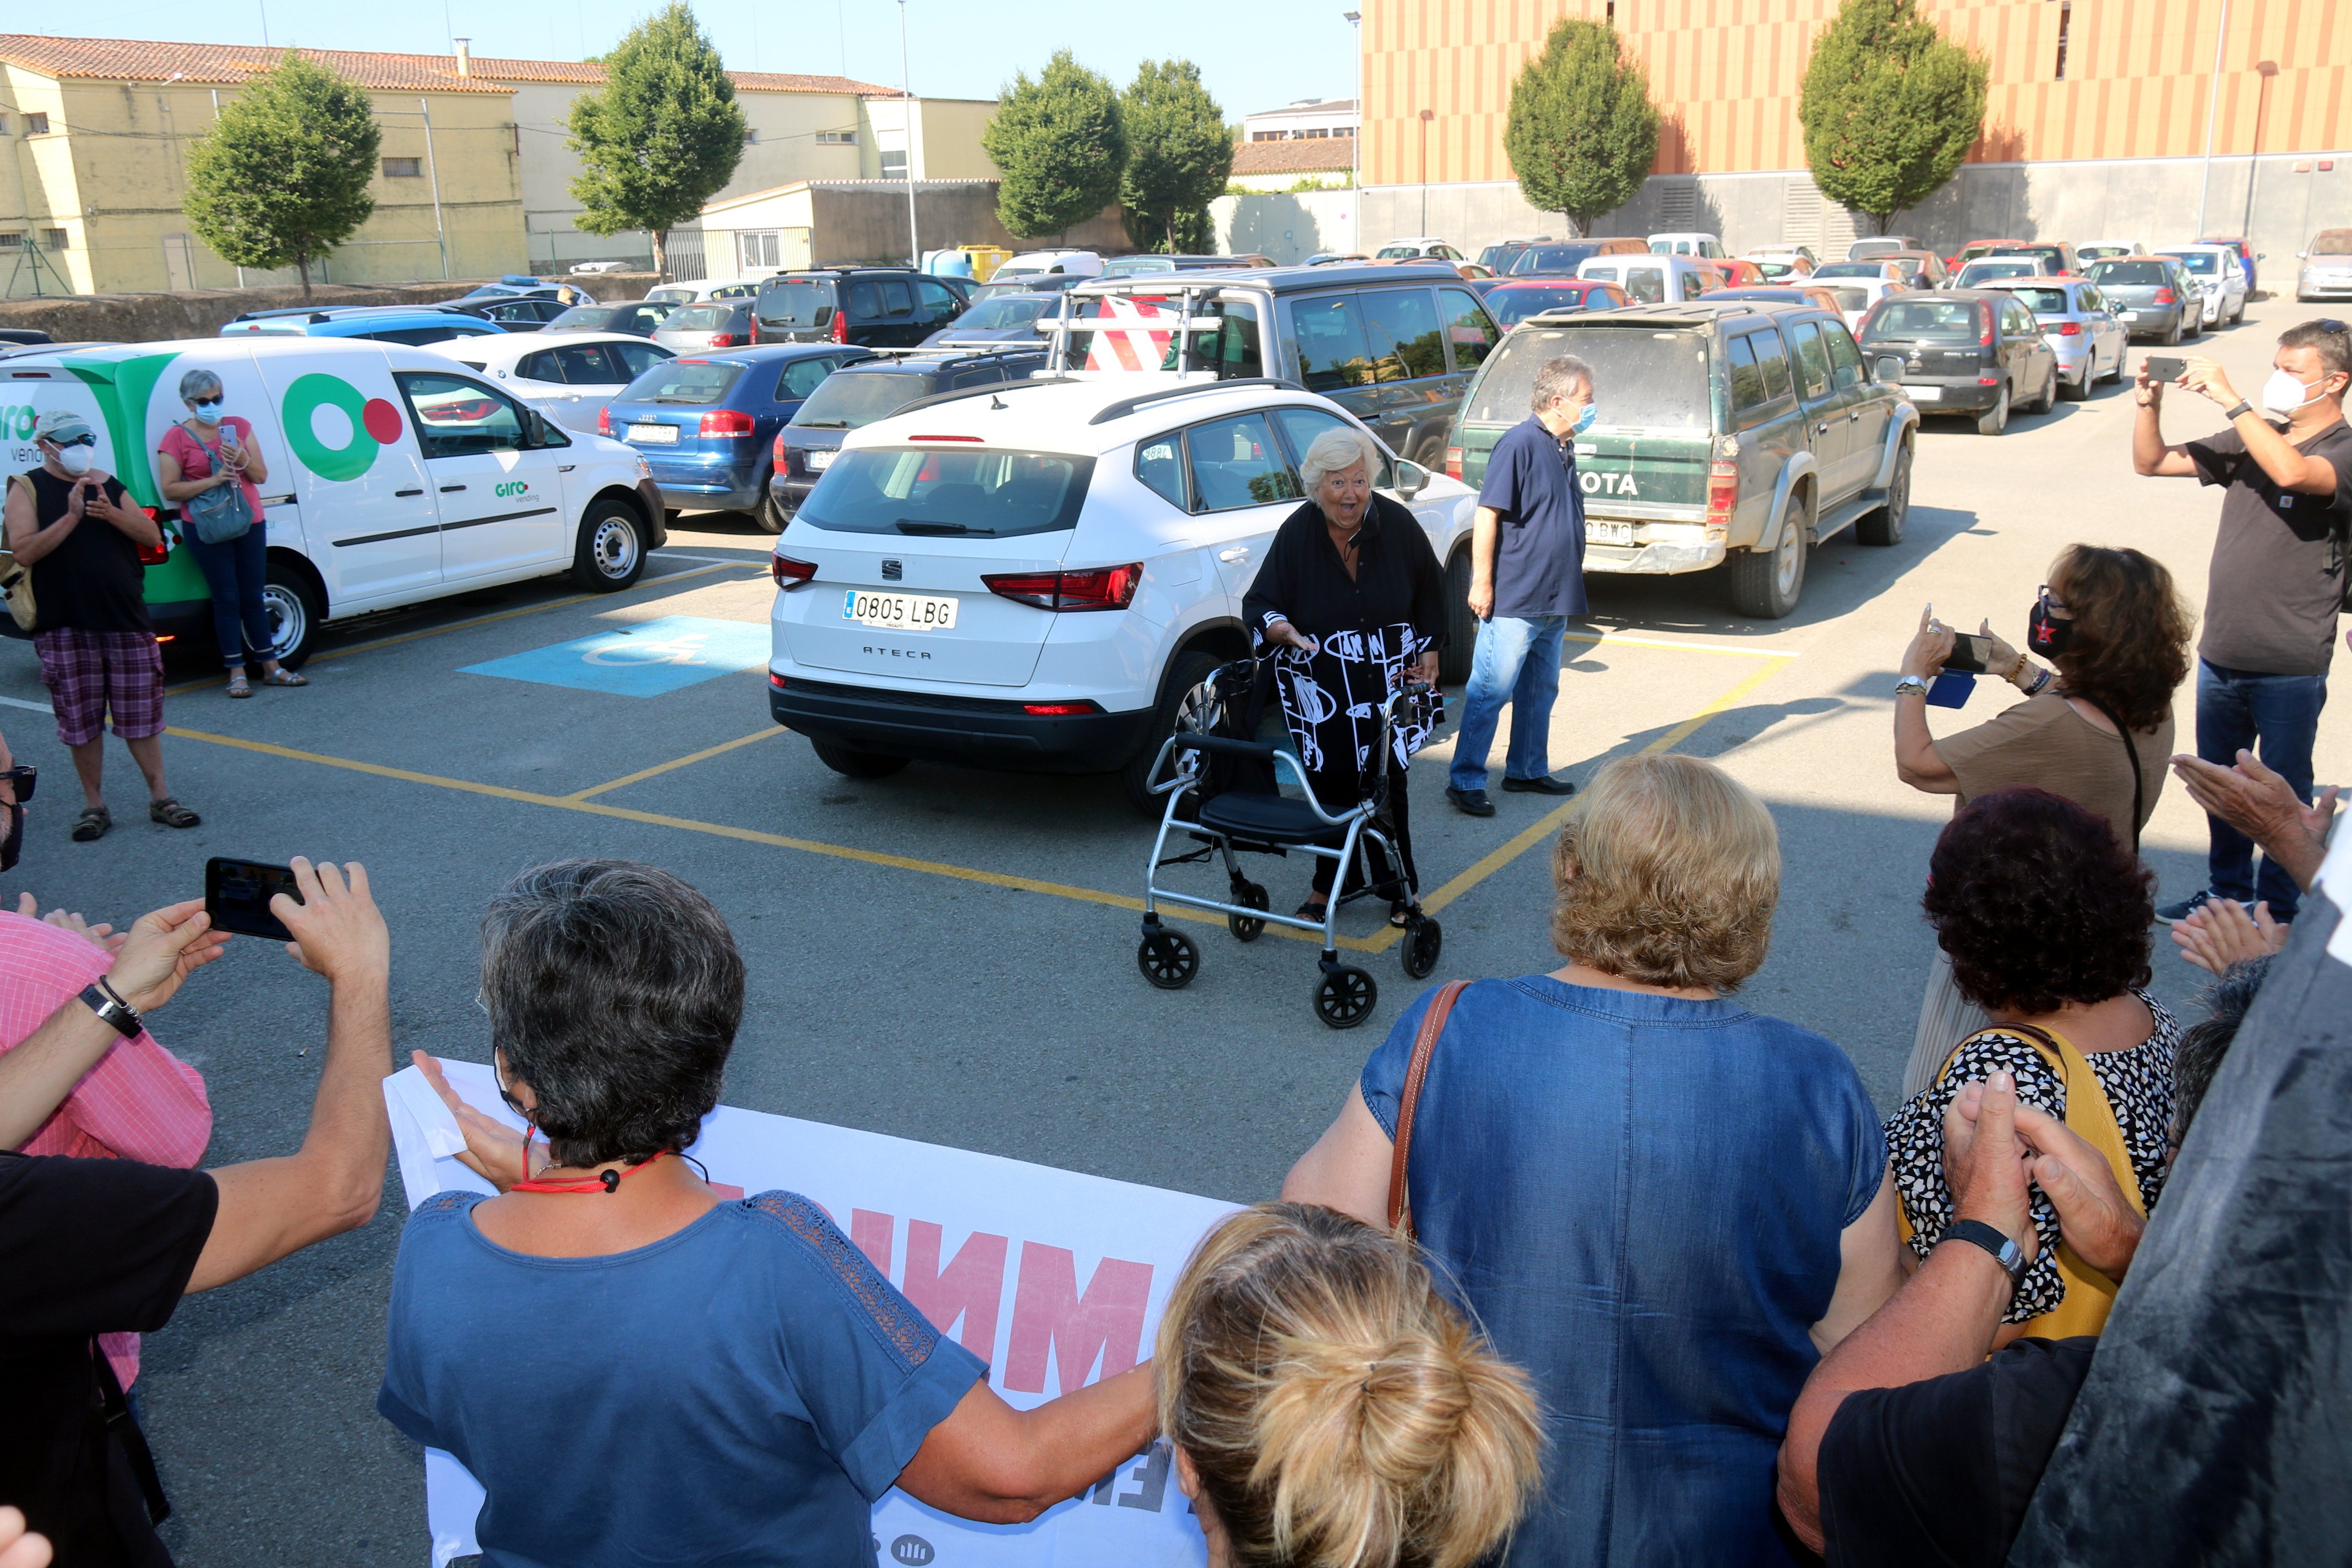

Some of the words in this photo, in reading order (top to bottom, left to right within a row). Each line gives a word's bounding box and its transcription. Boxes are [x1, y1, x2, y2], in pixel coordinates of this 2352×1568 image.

[515, 494, 539, 503] vending
[1600, 523, 1629, 539] BWC
[857, 597, 903, 620] 0805
[912, 601, 949, 624] LBG
[863, 646, 931, 659] ATECA
